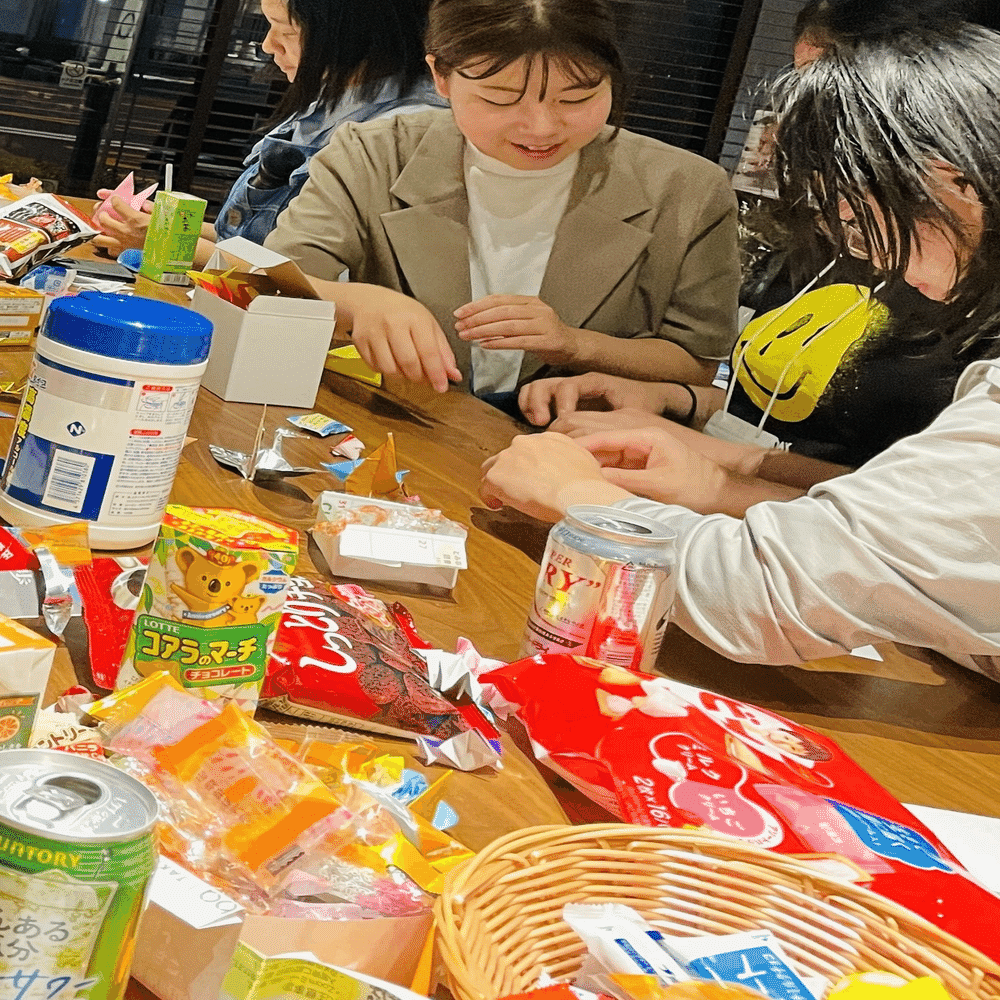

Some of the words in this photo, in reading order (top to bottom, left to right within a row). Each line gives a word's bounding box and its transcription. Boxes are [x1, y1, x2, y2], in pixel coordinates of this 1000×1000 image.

[143, 618, 181, 635] LOTTE
[140, 629, 259, 666] コアラのマーチ
[189, 666, 251, 680] チョコレート
[34, 726, 87, 749] ントリー
